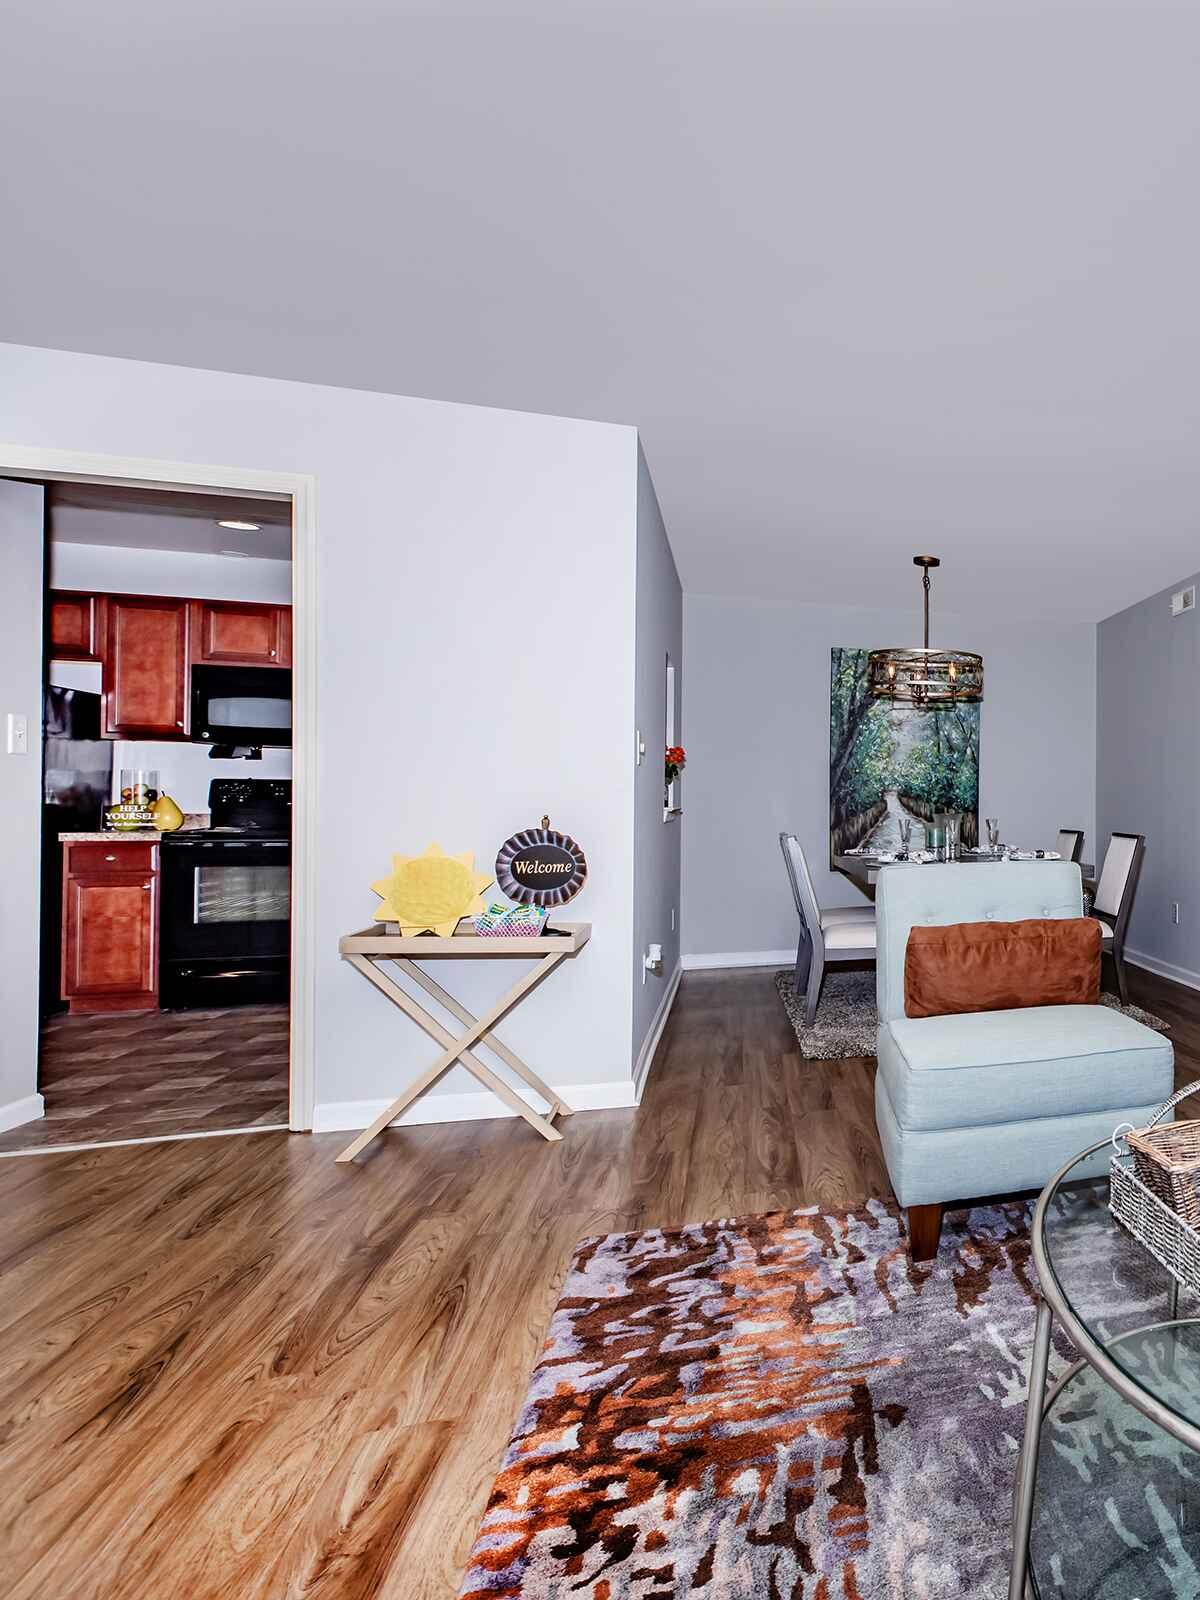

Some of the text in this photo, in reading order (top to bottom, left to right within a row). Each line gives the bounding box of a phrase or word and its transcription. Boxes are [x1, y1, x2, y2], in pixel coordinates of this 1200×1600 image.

[120, 804, 147, 812] HELP
[105, 812, 160, 820] YOURSELF
[514, 860, 572, 875] Welcome
